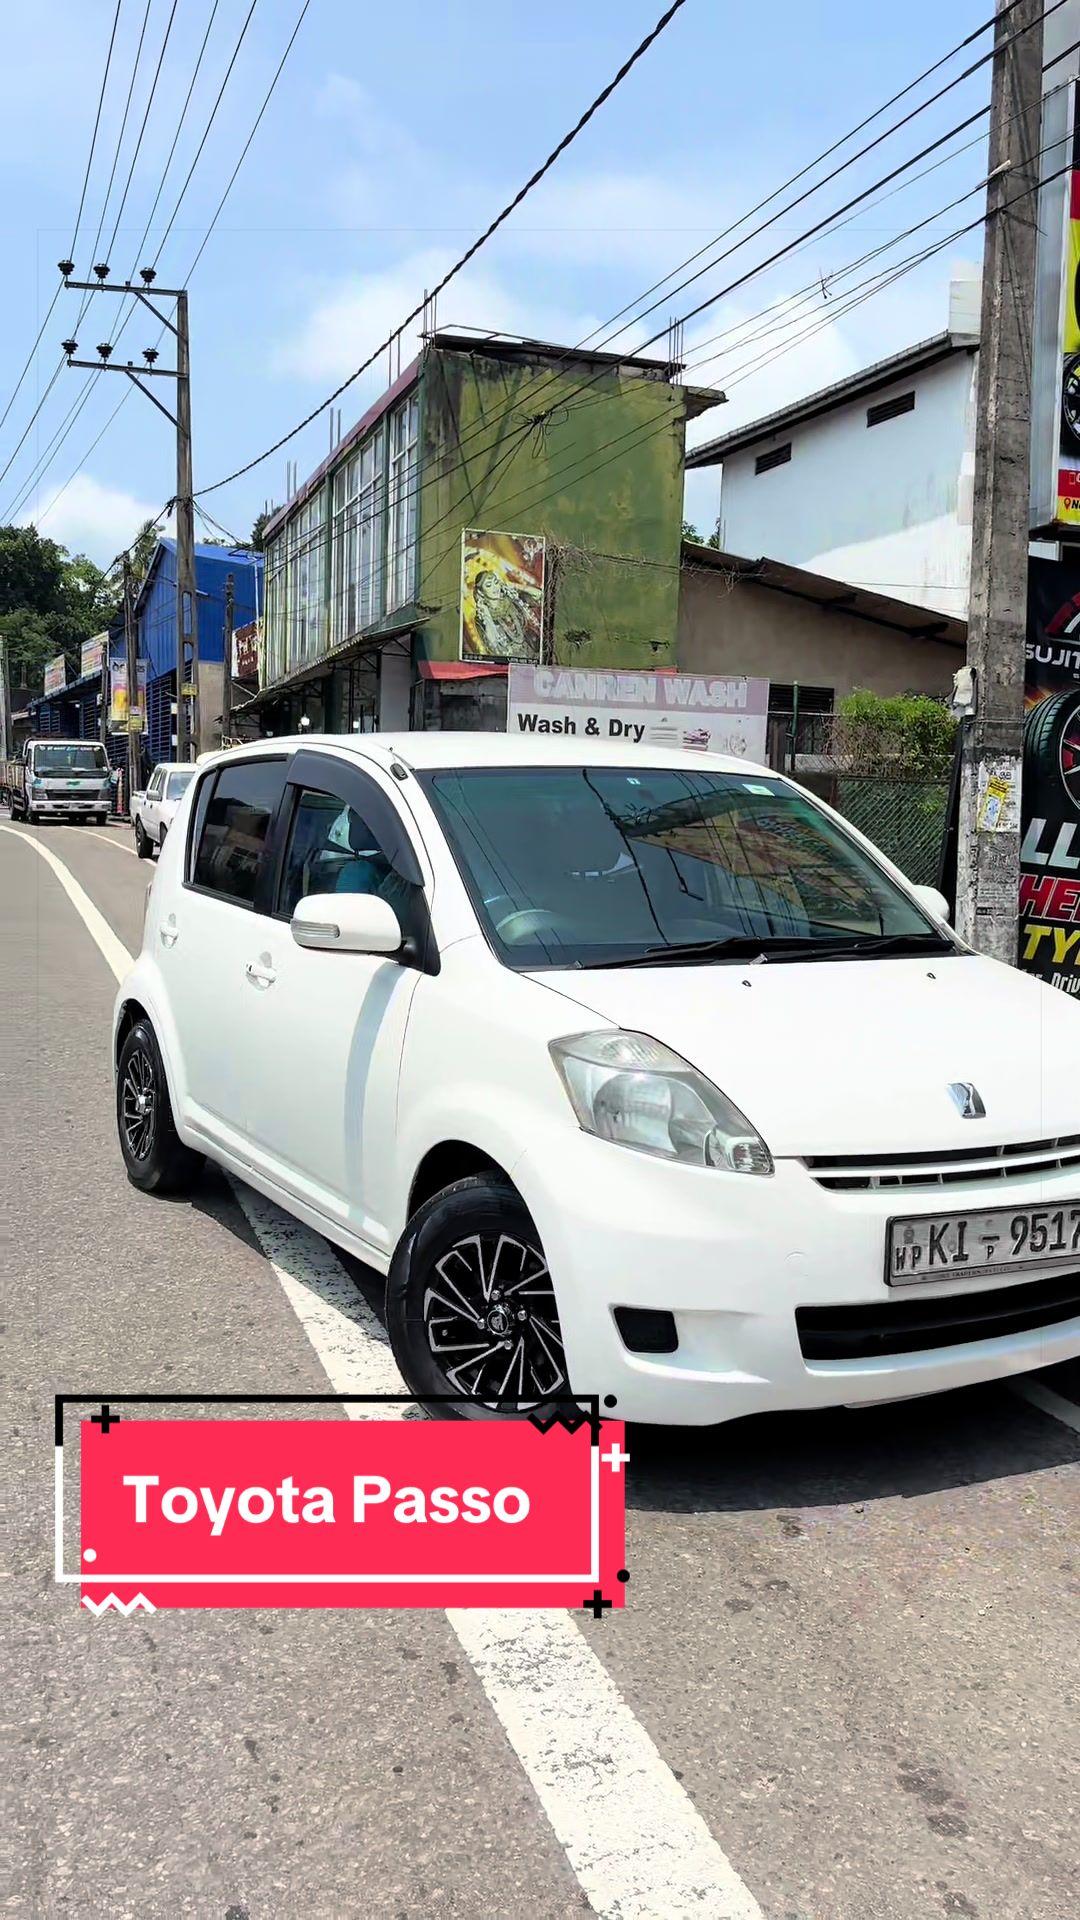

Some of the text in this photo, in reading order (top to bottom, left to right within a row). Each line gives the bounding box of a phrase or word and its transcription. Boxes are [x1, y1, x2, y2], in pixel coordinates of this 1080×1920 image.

[664, 679, 747, 708] WASH
[517, 713, 645, 743] Wash & Dry
[1019, 873, 1080, 923] HE
[1023, 924, 1080, 966] TY
